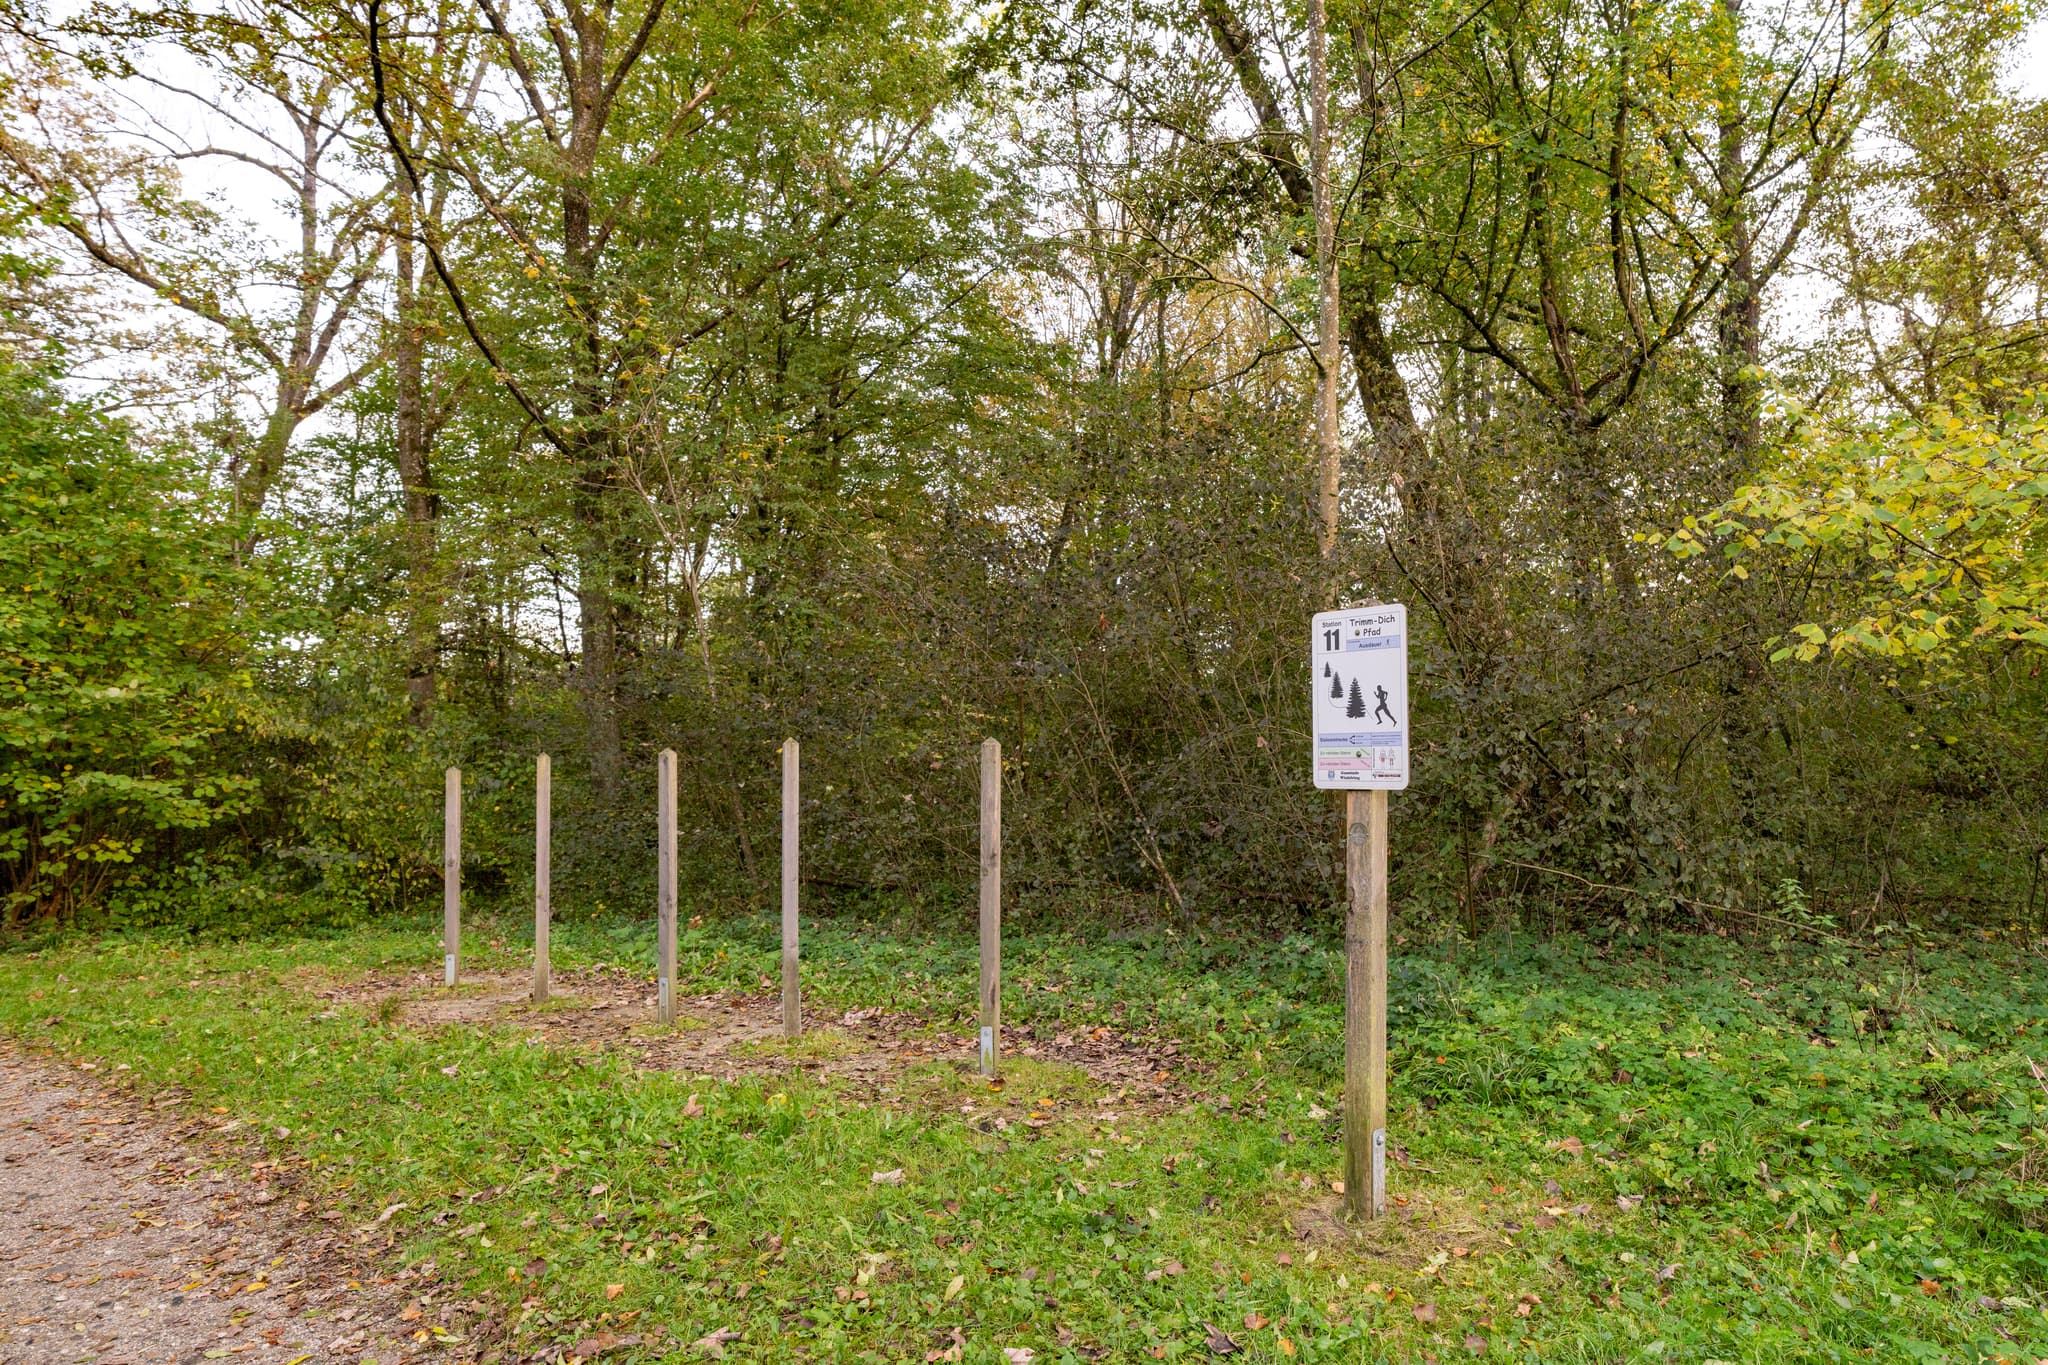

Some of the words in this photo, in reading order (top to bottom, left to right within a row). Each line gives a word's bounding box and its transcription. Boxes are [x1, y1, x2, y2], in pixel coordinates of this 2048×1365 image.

[1350, 615, 1395, 627] Trimm-Dich
[1363, 627, 1381, 637] Pfad
[1323, 629, 1340, 651] 11
